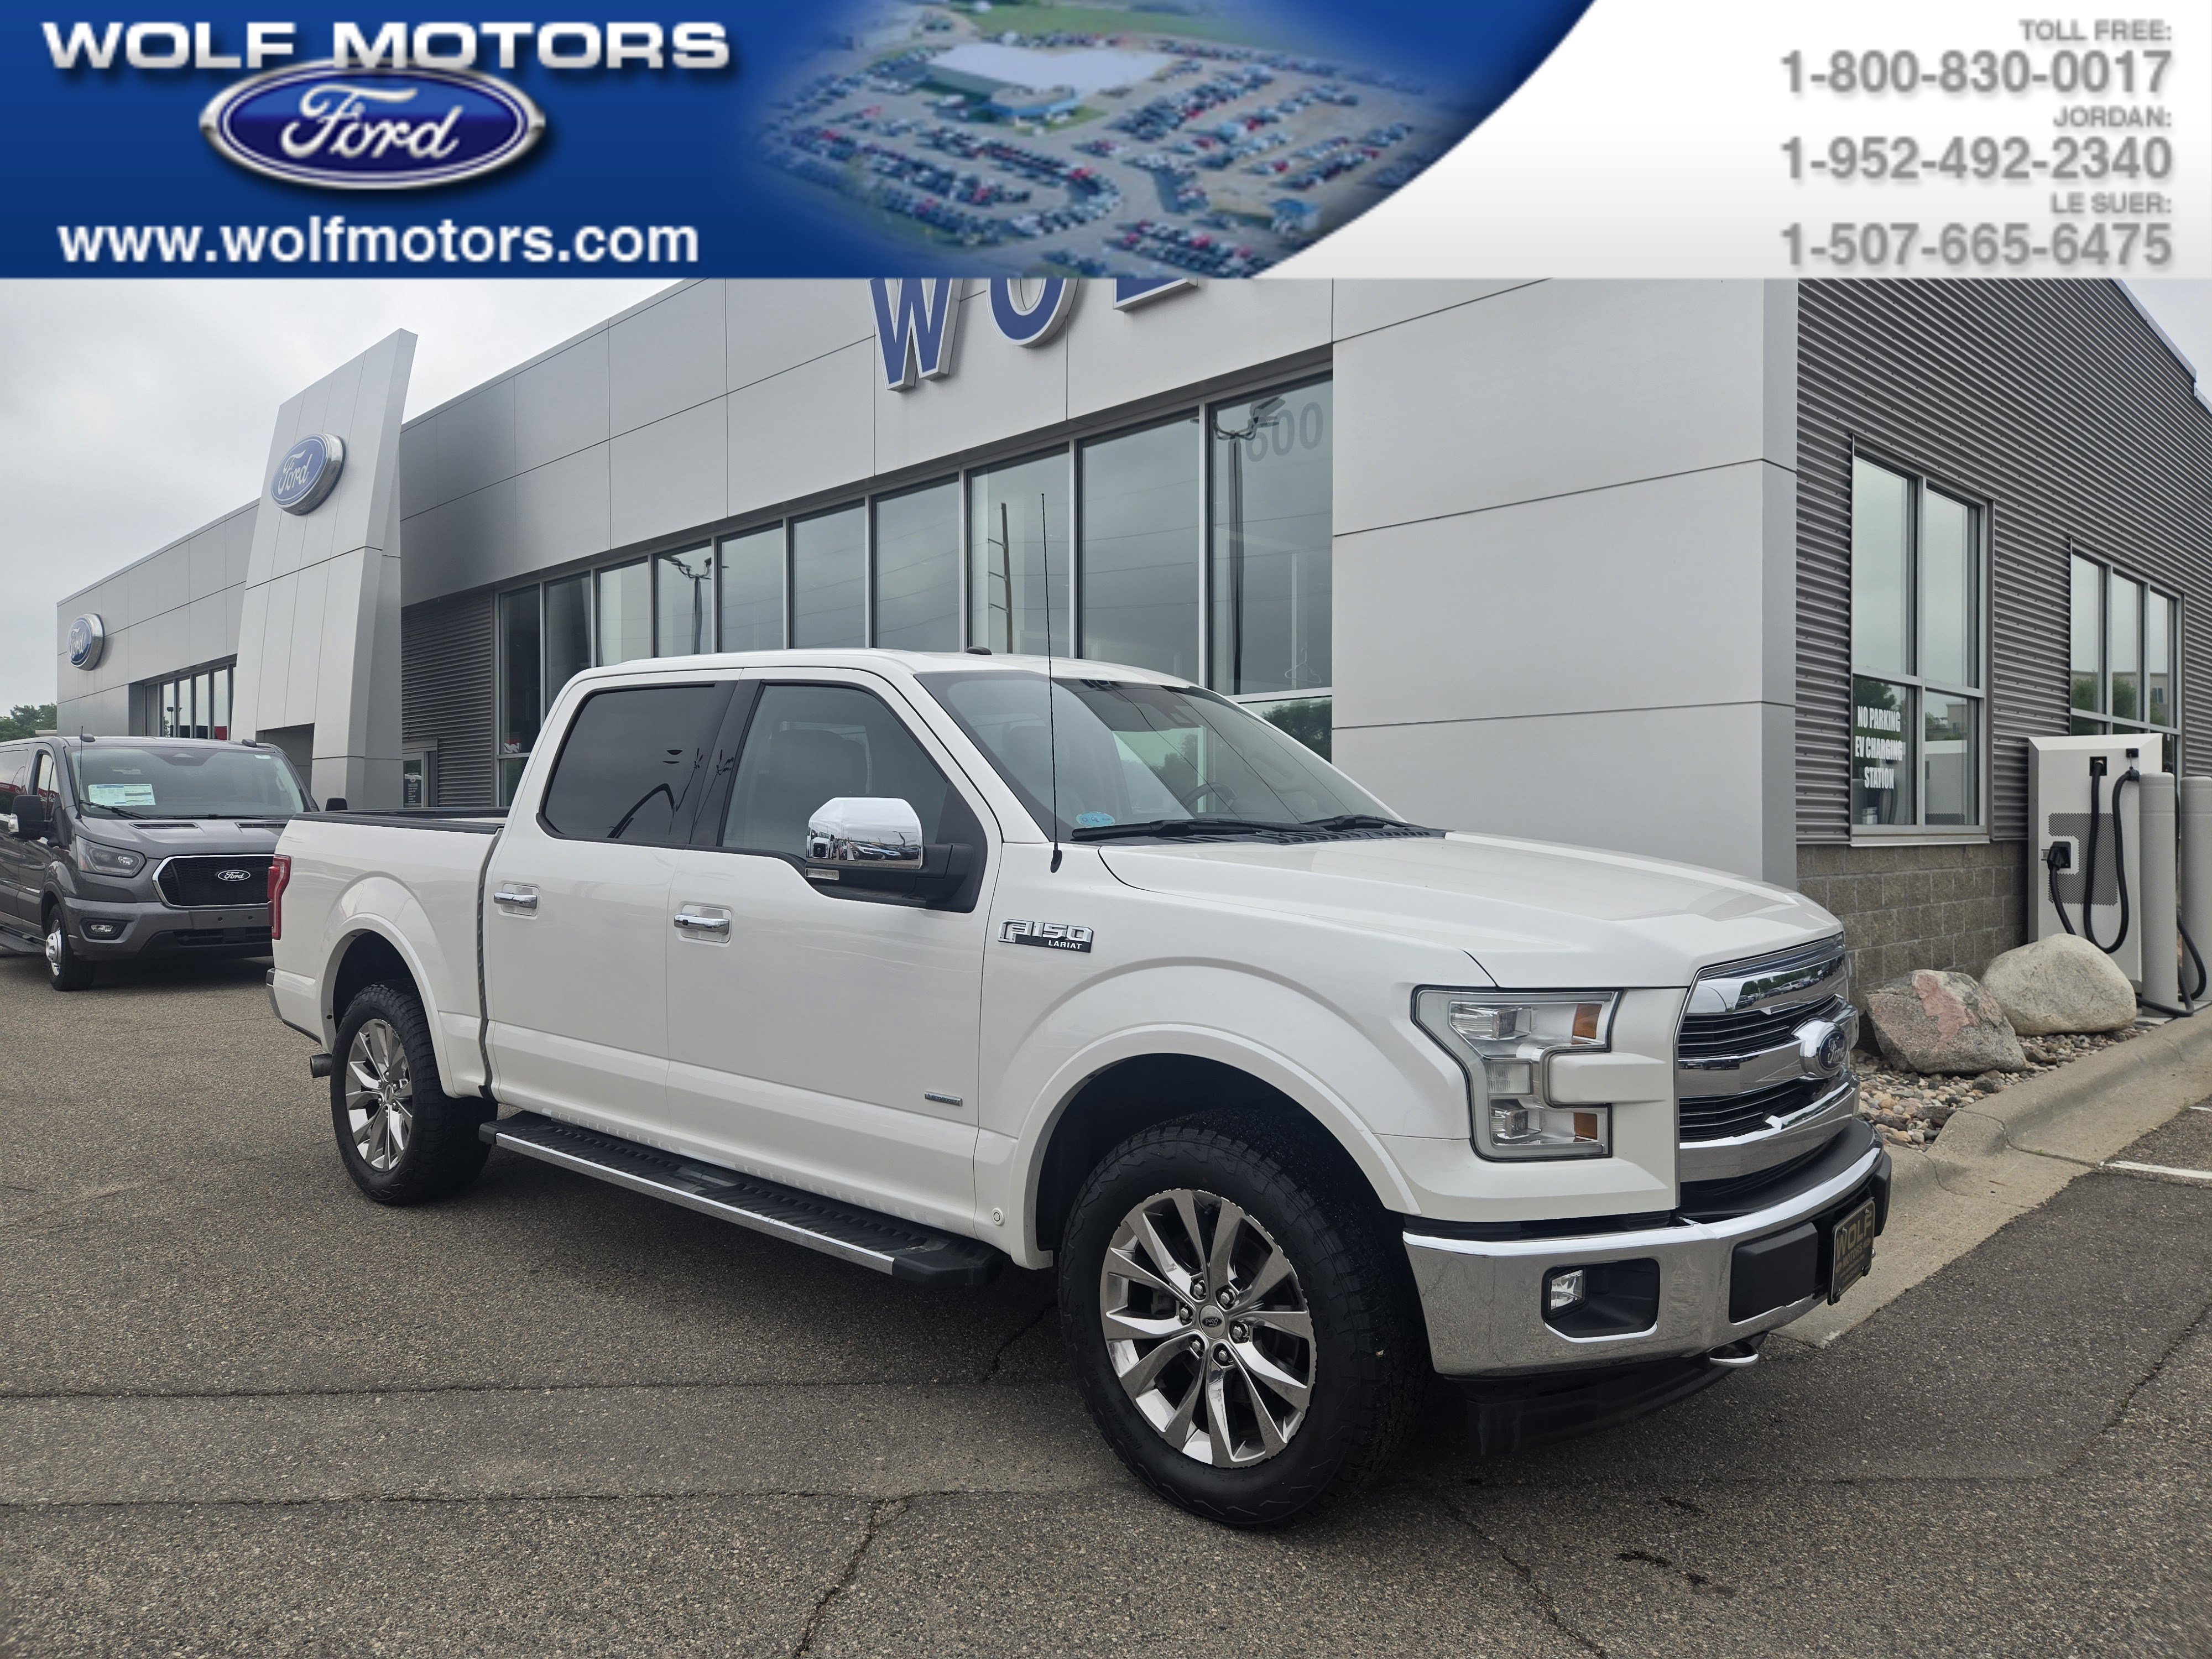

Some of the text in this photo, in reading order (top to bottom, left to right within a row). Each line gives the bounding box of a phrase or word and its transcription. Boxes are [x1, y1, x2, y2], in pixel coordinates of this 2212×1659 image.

[278, 450, 313, 495] Ford
[1858, 705, 1901, 732] NO PARKING
[1855, 735, 1903, 761] EV CHARGING
[1864, 766, 1895, 790] STATION
[224, 871, 244, 879] Ford
[1048, 940, 1082, 950] LARIAT
[1827, 1036, 1845, 1065] Ford
[1836, 1211, 1872, 1261] WOLF
